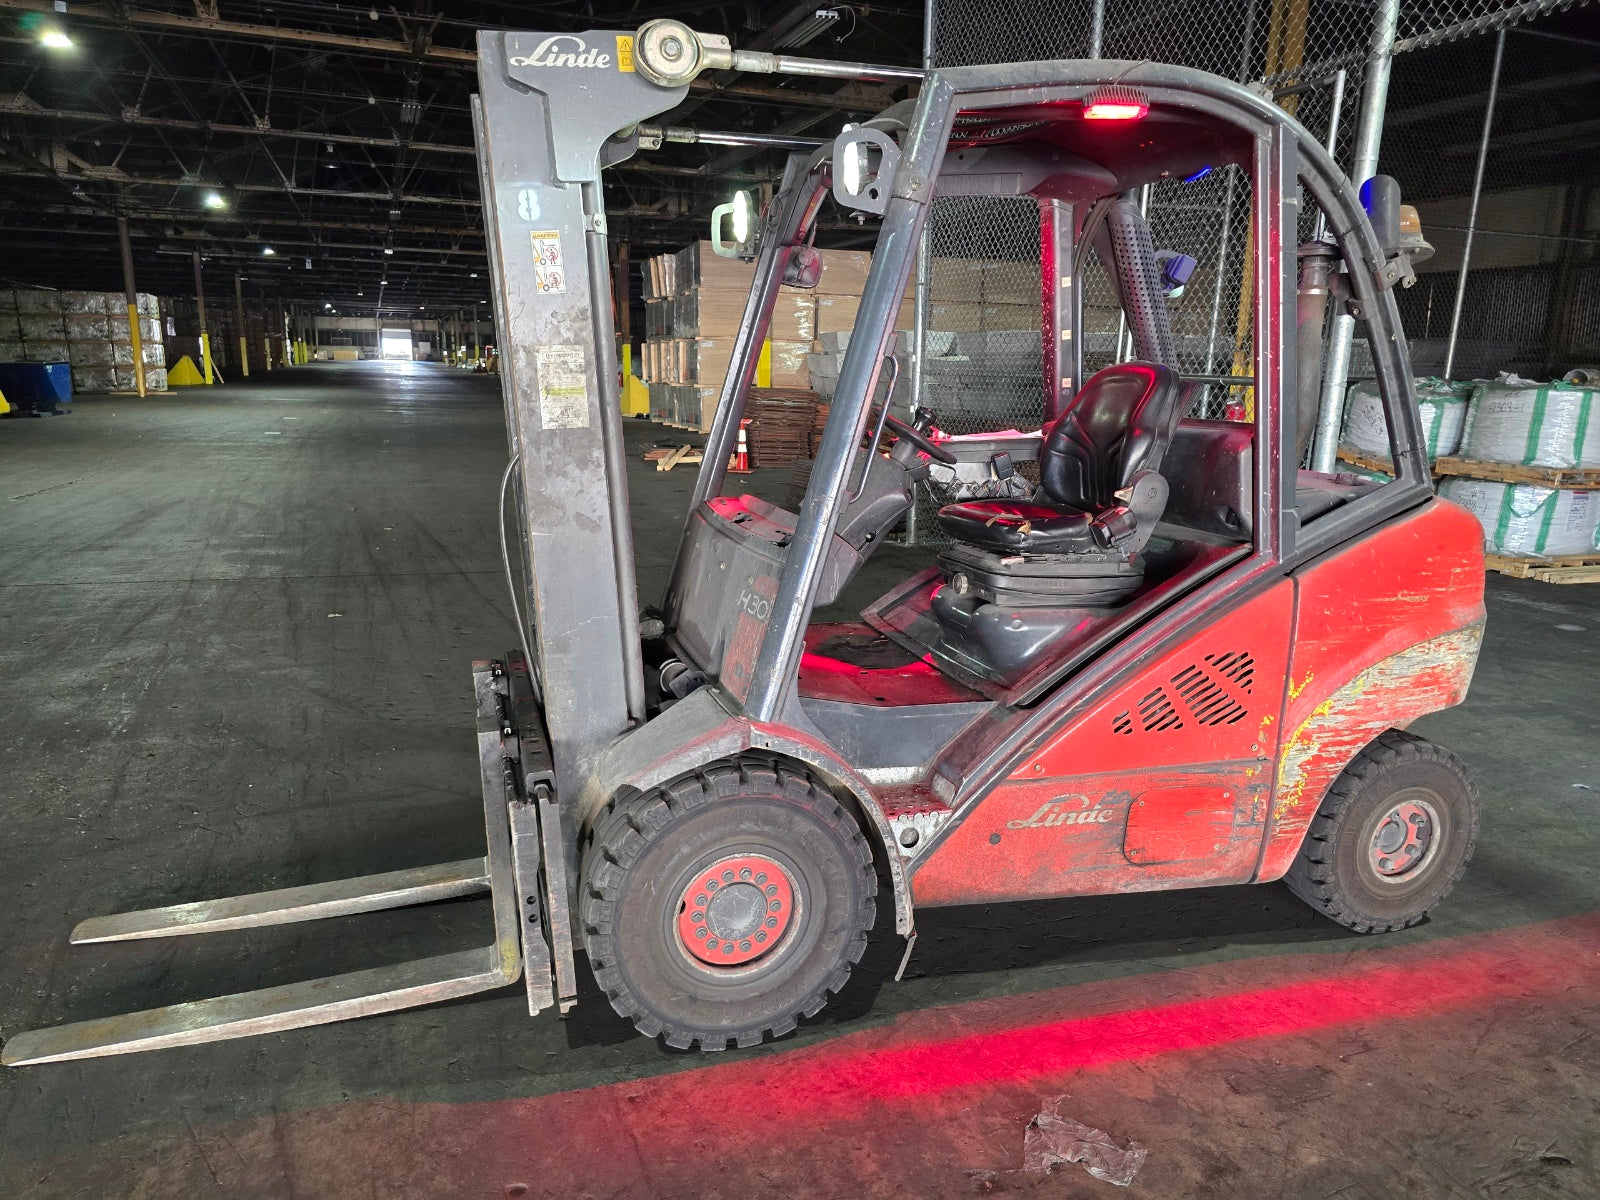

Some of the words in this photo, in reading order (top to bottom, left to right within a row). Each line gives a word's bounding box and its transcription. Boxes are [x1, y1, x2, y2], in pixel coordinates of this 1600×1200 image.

[510, 36, 611, 68] Linde
[518, 189, 540, 221] 8
[1007, 793, 1113, 829] Linde
